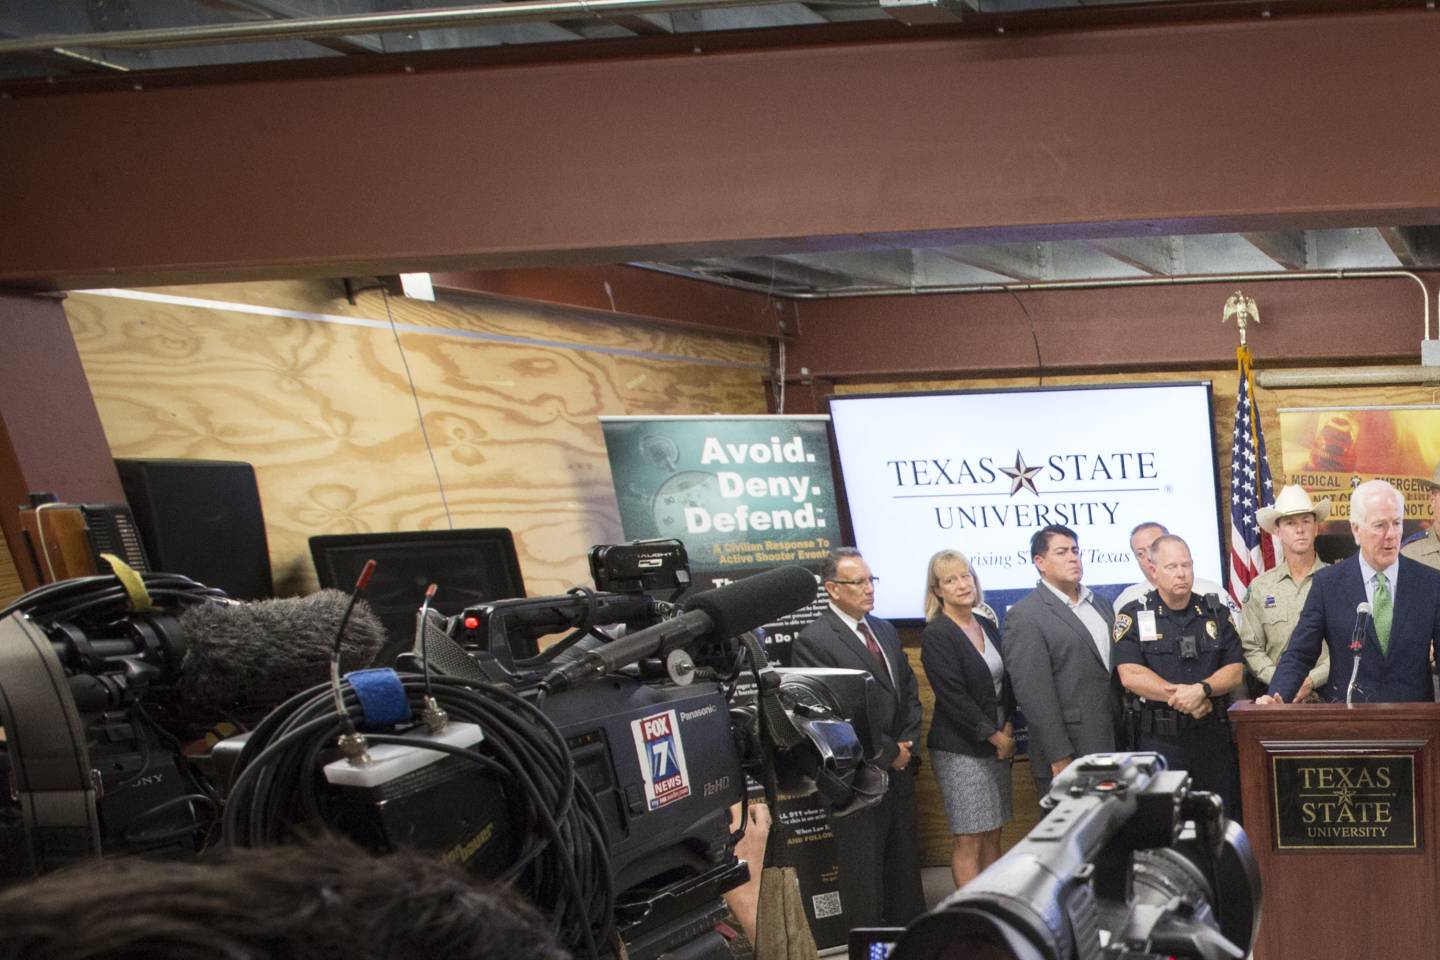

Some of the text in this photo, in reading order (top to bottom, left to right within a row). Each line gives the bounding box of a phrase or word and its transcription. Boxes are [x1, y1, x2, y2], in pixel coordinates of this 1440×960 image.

[701, 436, 816, 465] Avoid.
[887, 452, 1158, 487] TEXAS STATE
[717, 471, 821, 503] Deny.
[1292, 474, 1341, 488] MEDICAL
[684, 502, 826, 534] Defend.
[934, 502, 1120, 530] UNIVERSITY
[1330, 504, 1351, 517] LICE
[723, 542, 763, 553] Civilian
[765, 539, 815, 551] Response
[816, 538, 830, 548] To
[719, 553, 753, 564] Active
[755, 552, 795, 562] Shooter
[1089, 549, 1131, 565] Texas
[680, 703, 718, 722] Panasonic
[644, 717, 670, 740] FOX
[652, 741, 669, 777] 7
[655, 775, 682, 795] NEWS
[1298, 766, 1391, 789] TEXAS
[1302, 802, 1392, 823] STATE
[1308, 826, 1388, 838] UNIVERSITY
